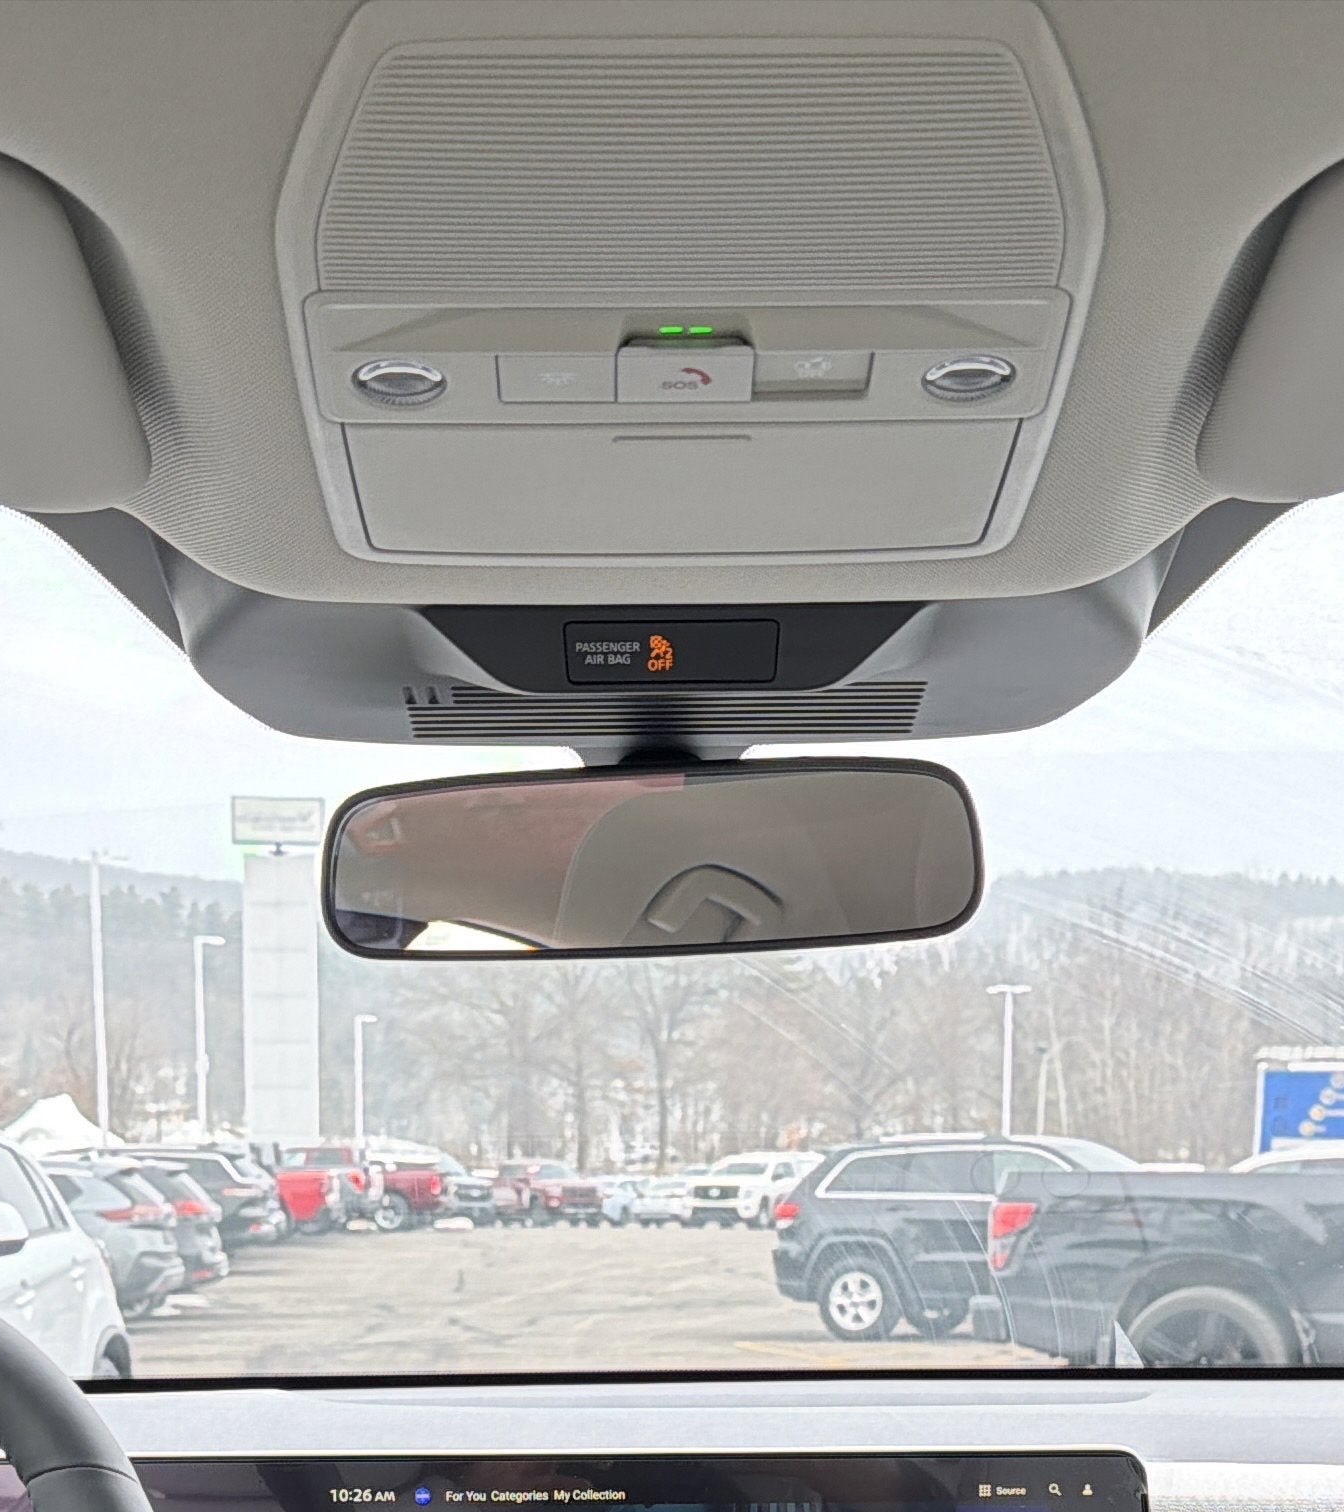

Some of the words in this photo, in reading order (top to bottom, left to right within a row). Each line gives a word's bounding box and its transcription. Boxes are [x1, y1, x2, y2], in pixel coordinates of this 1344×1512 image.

[662, 381, 698, 390] SOS
[575, 642, 640, 653] PASSENGER
[585, 655, 604, 664] AIR
[608, 655, 631, 664] BAG
[647, 660, 673, 671] OFF
[330, 1489, 372, 1502] 10:26
[375, 1491, 395, 1502] AM
[446, 1491, 463, 1501] For
[466, 1491, 486, 1501] You
[490, 1490, 548, 1503] Categories
[554, 1490, 570, 1502] My
[573, 1490, 626, 1500] Collection
[996, 1486, 1026, 1496] Source
